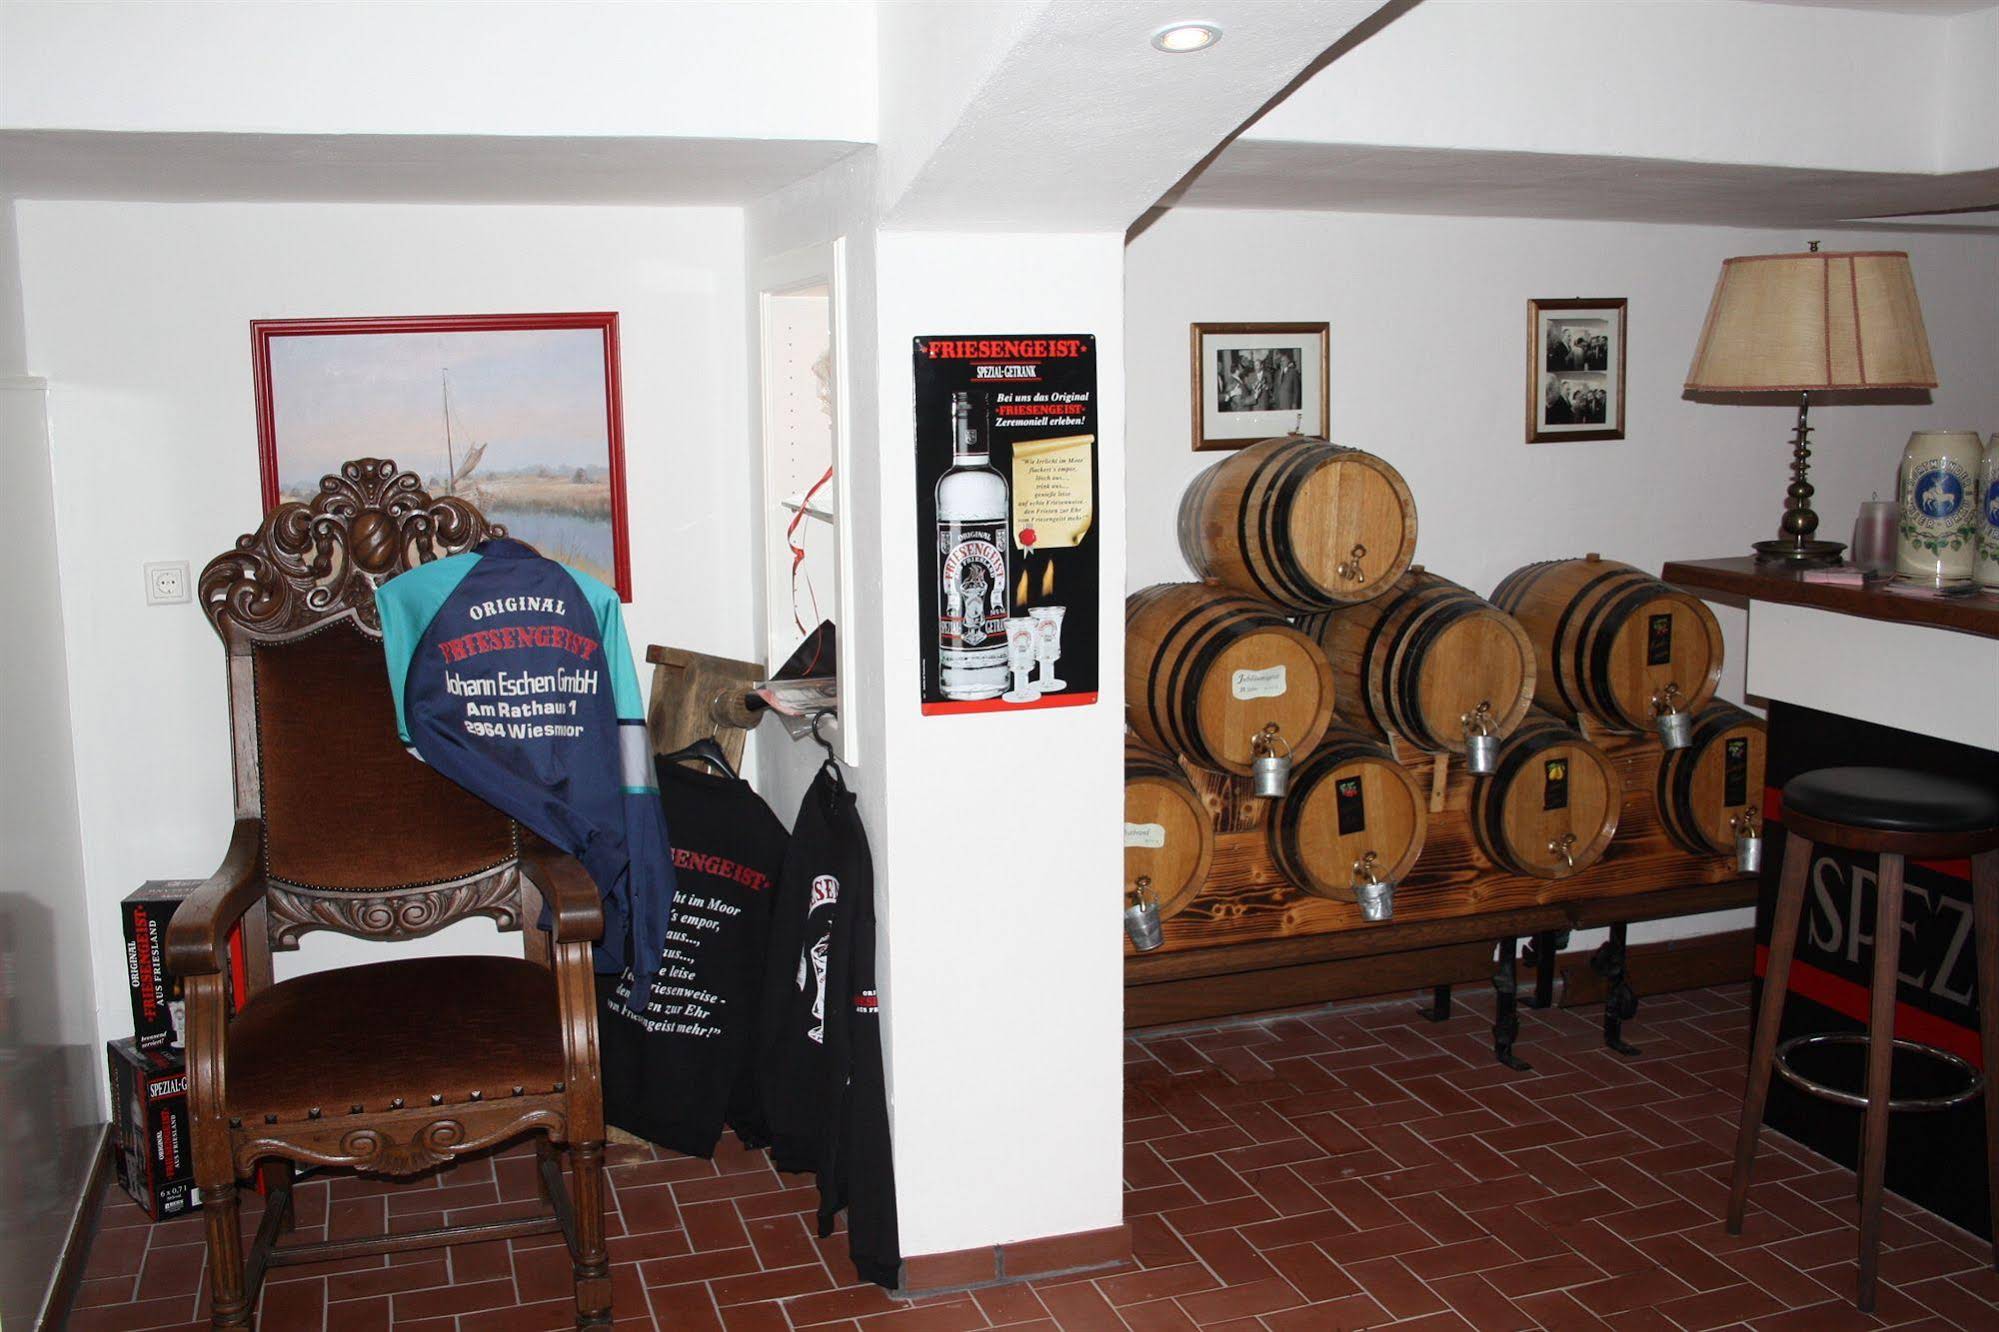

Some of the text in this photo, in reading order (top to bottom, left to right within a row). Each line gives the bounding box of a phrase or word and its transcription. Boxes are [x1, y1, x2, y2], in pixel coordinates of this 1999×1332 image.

[928, 340, 1080, 358] FRIESENGEIST
[997, 392, 1089, 403] Bei uns das Original
[1000, 404, 1082, 416] FRIESENGEIST
[995, 416, 1085, 427] Zeremoniell erleben!
[469, 596, 566, 620] ORIGINAL
[498, 670, 556, 697] Eschen
[557, 667, 598, 695] GmbH
[467, 702, 496, 717] Am
[568, 700, 577, 715] 1
[464, 721, 506, 737] 2964
[688, 894, 705, 908] im
[707, 898, 742, 916] Moor
[680, 913, 720, 933] empor,
[128, 940, 141, 988] ORIGINAL
[148, 920, 165, 1007] AUS FRIESLAND
[669, 965, 696, 981] leise
[665, 1004, 683, 1015] zur
[684, 1003, 711, 1019] Ehr
